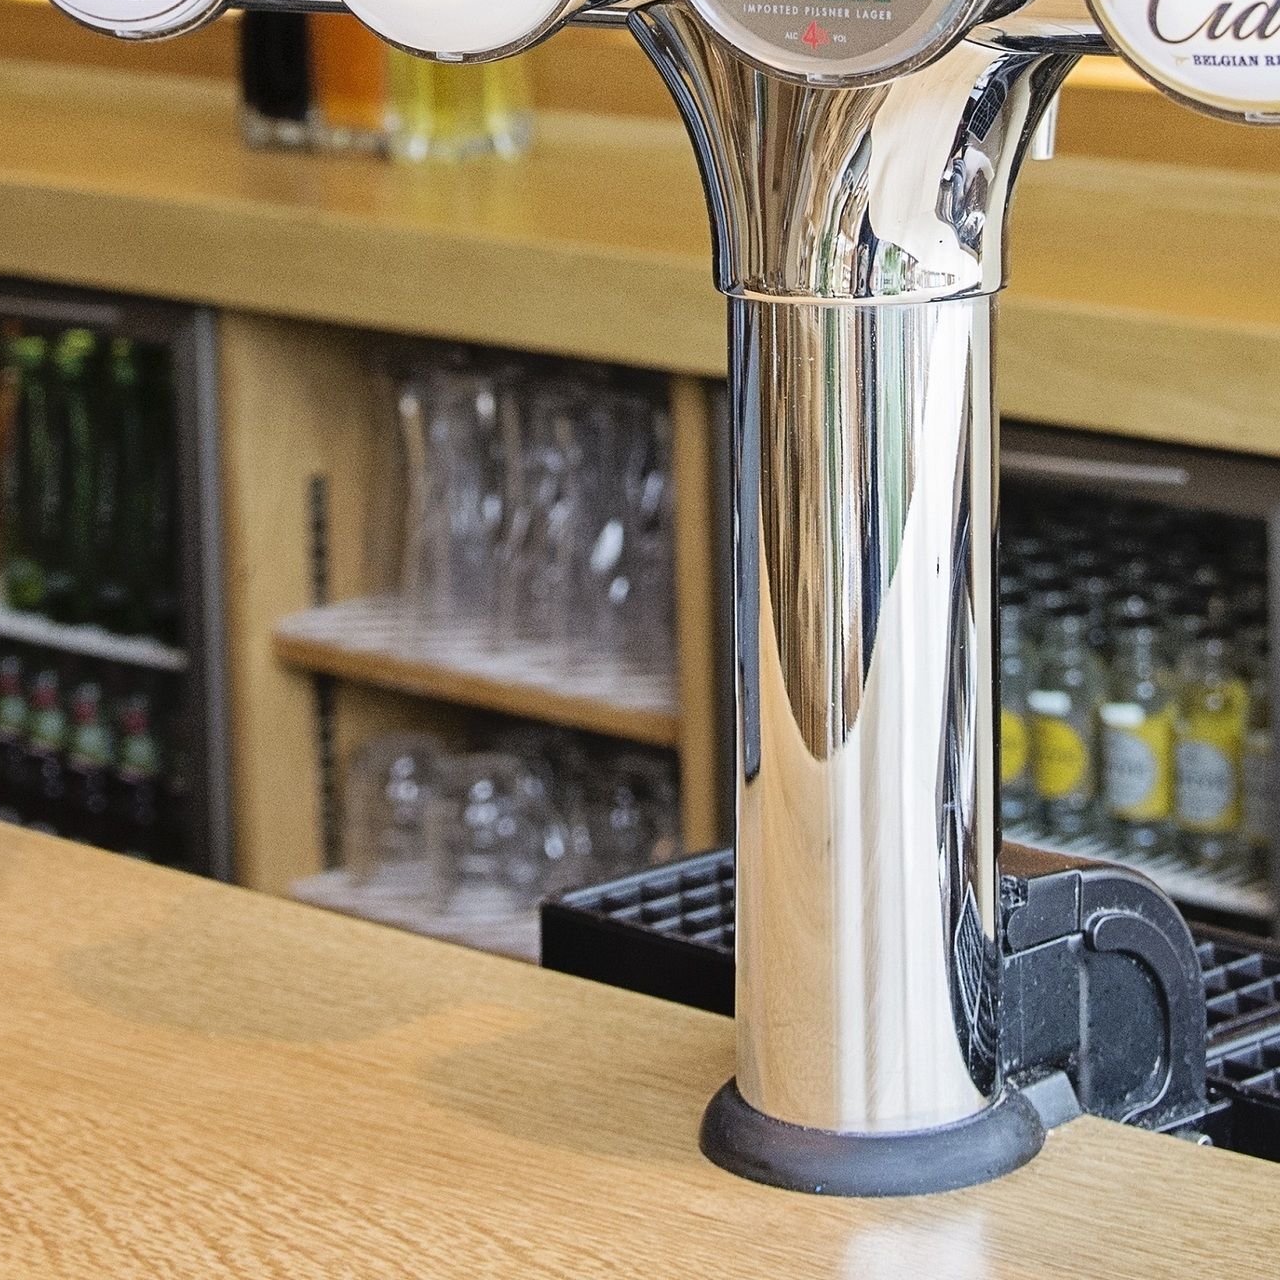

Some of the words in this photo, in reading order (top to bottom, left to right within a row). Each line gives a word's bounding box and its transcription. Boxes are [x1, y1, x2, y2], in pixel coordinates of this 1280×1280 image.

[742, 3, 799, 16] IMPORTED
[804, 6, 850, 18] PILSNER
[856, 9, 892, 20] LAGER
[1192, 53, 1259, 67] BELGIAN
